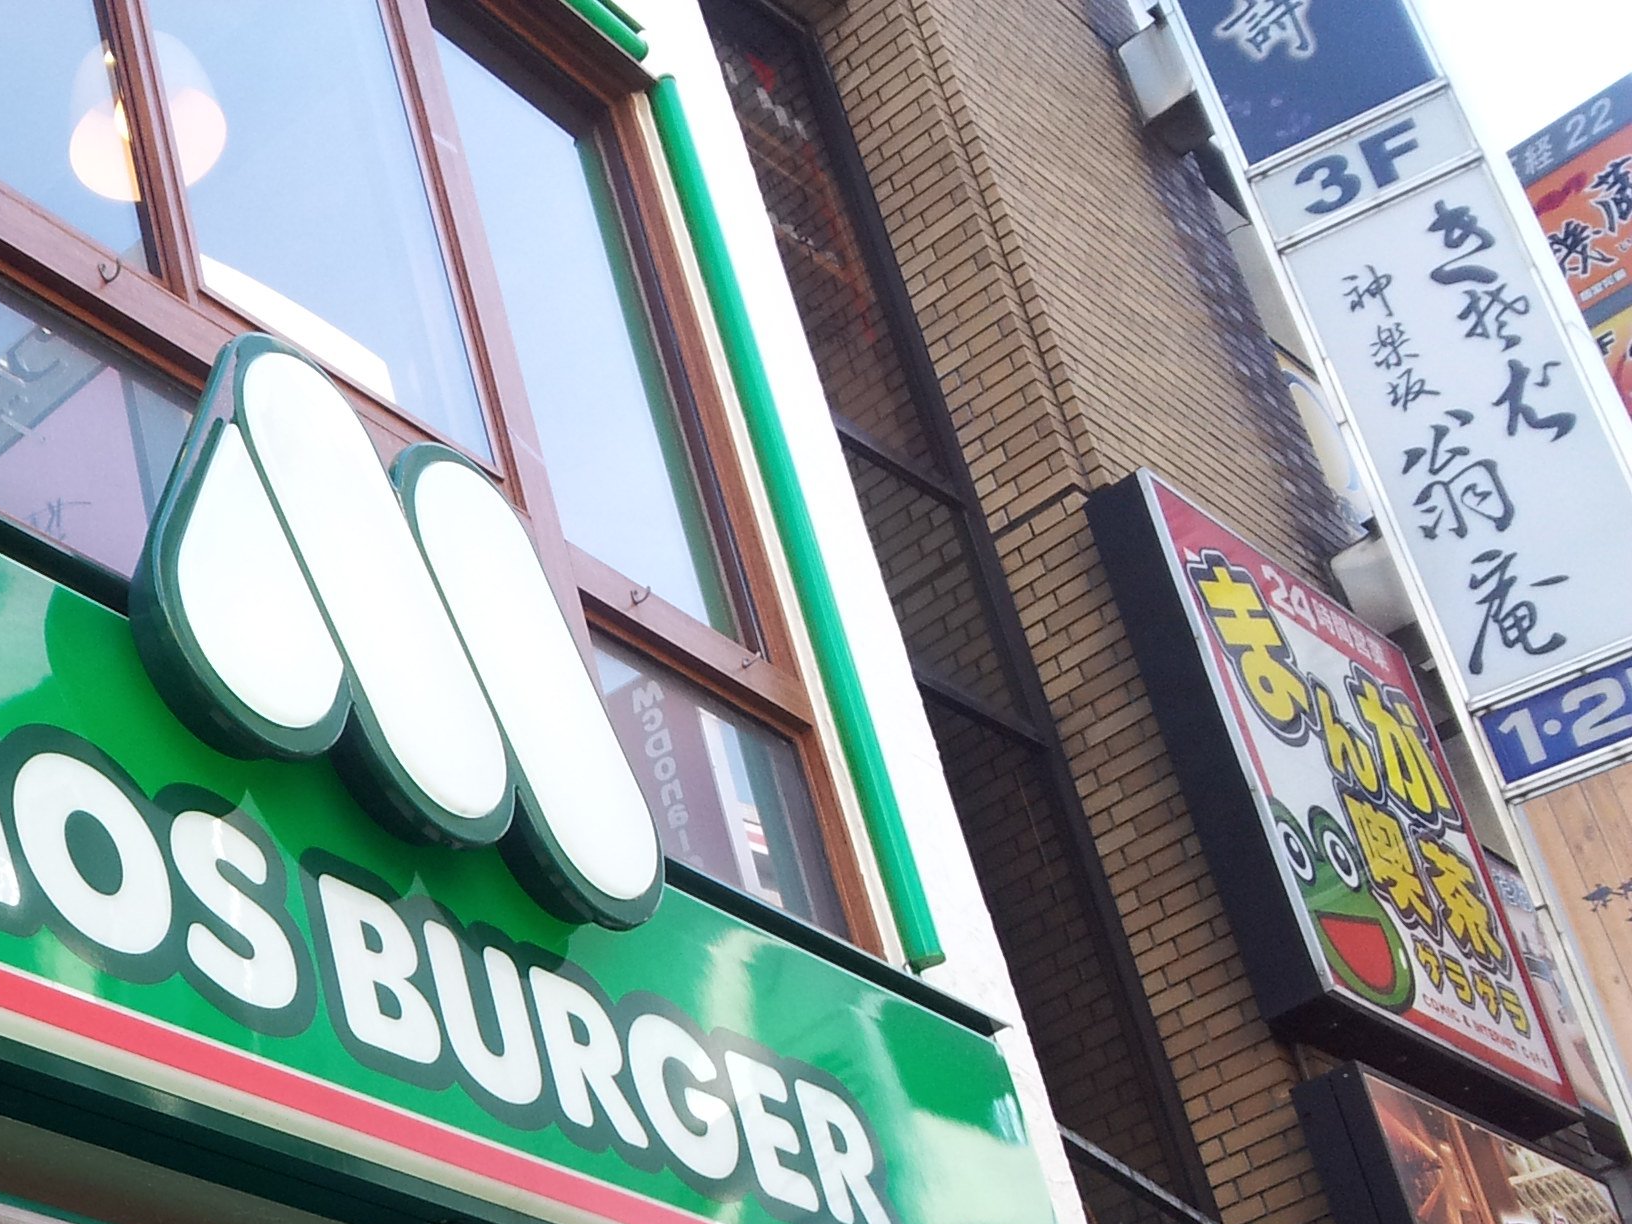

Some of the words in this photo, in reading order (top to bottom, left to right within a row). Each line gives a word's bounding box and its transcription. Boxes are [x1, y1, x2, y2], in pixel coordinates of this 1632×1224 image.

[1294, 117, 1420, 215] 3F
[1190, 556, 1458, 822] まんが
[1344, 790, 1508, 968] 喫茶
